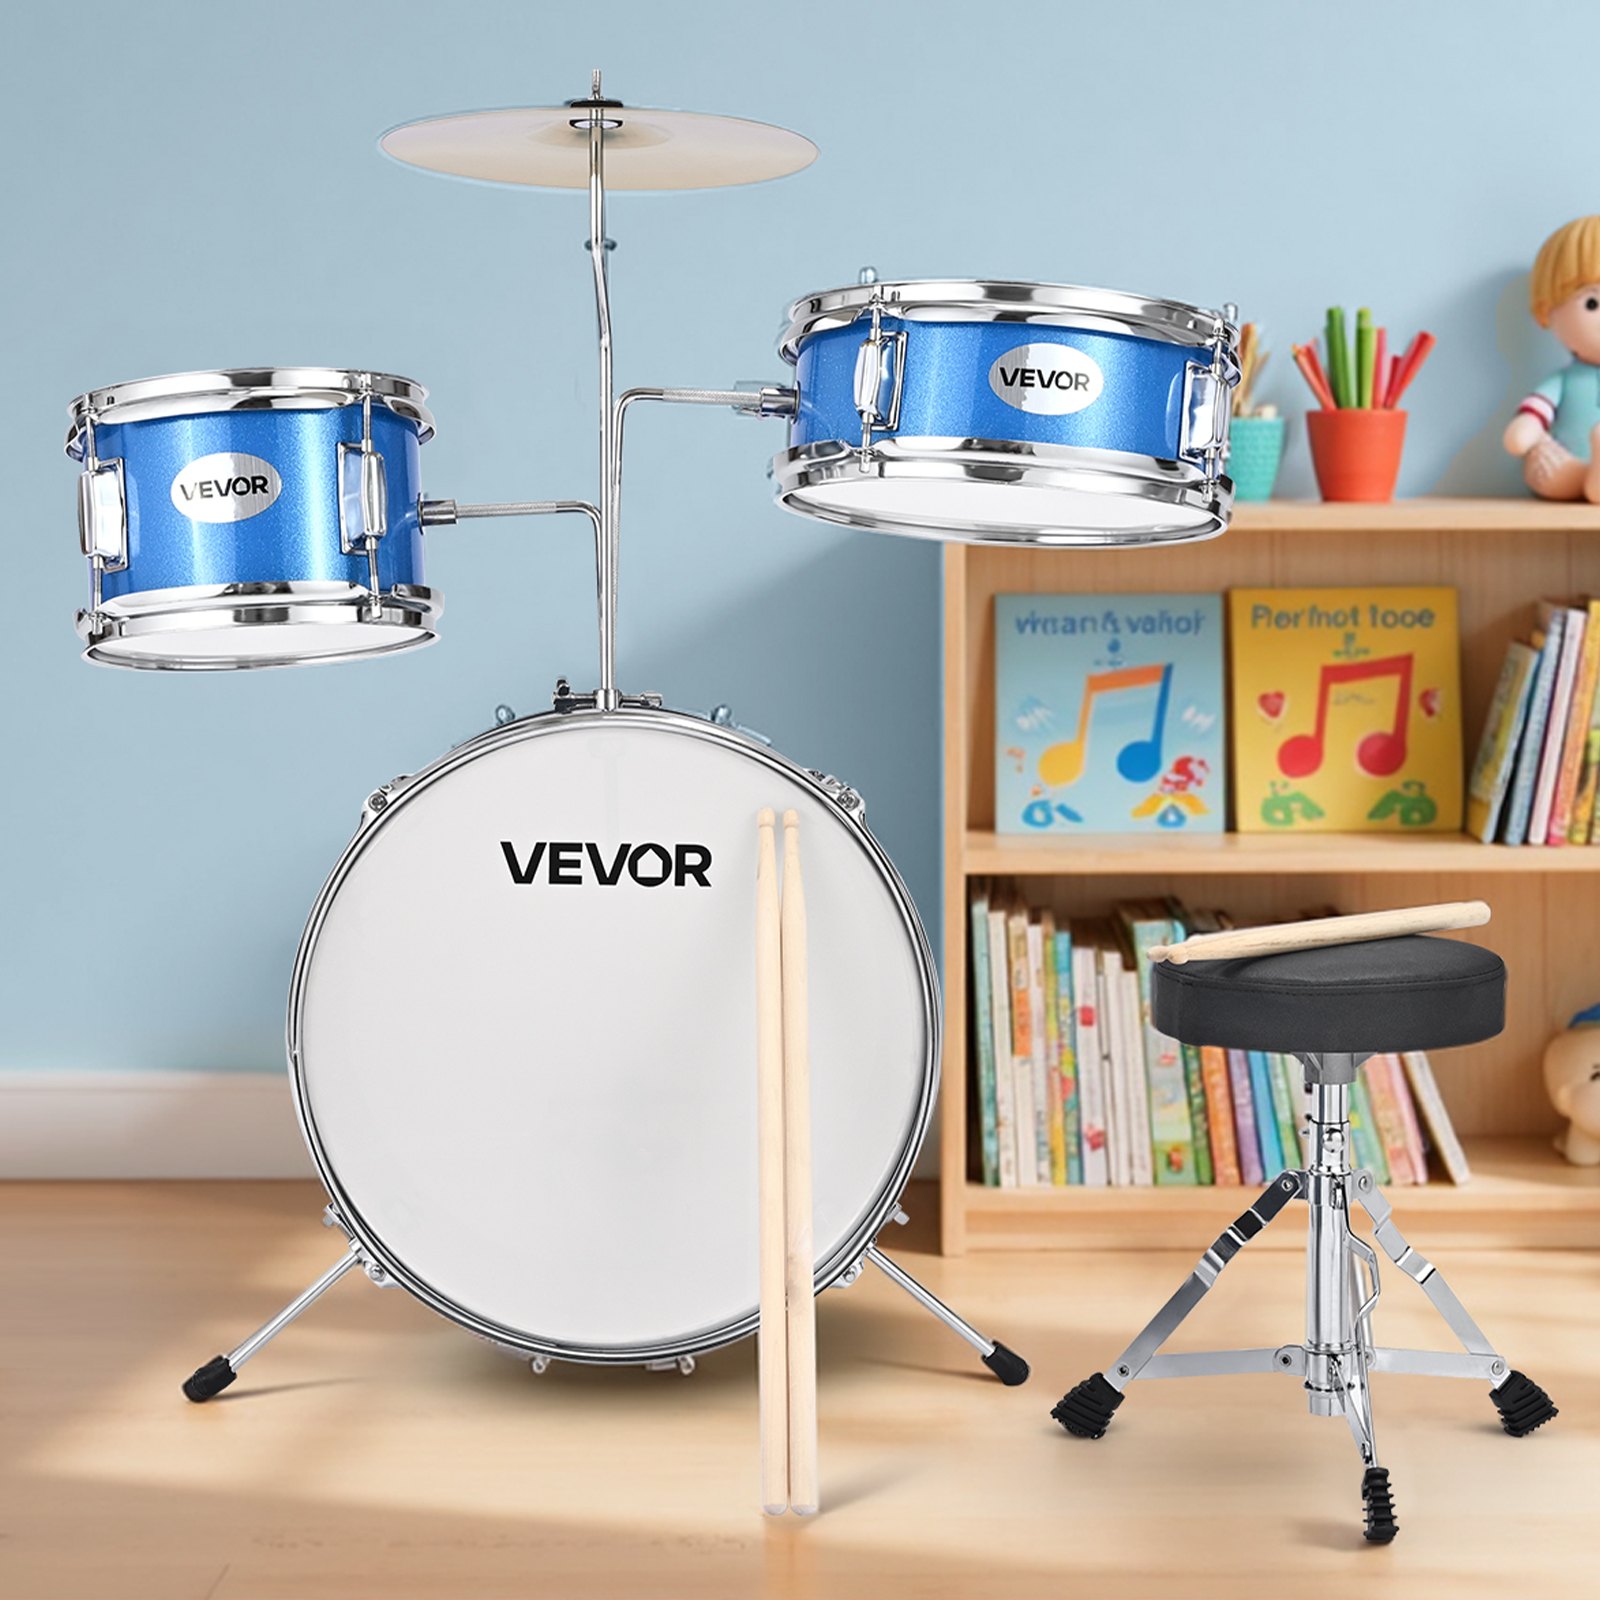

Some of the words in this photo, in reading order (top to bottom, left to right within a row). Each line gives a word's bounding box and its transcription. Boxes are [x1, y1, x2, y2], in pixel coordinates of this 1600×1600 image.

[999, 366, 1090, 392] VEVOR
[180, 475, 269, 501] VEVOR
[500, 841, 713, 888] VEVOR
